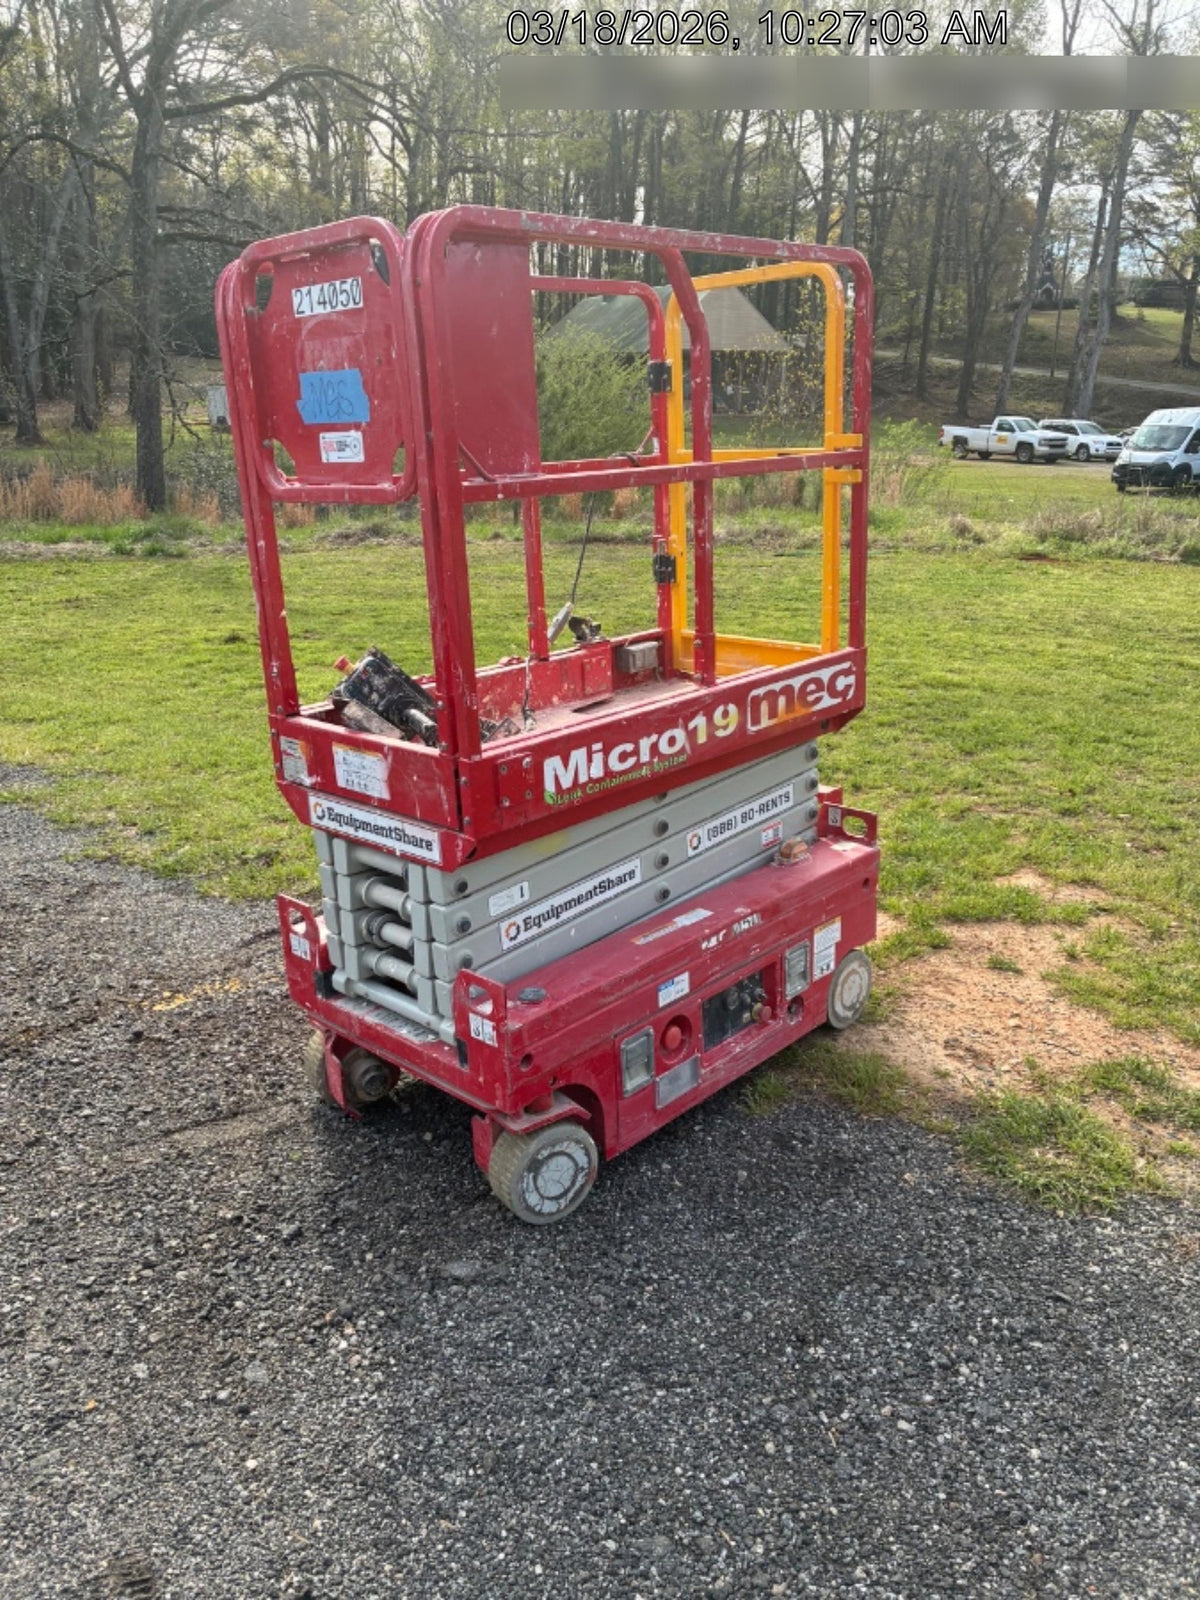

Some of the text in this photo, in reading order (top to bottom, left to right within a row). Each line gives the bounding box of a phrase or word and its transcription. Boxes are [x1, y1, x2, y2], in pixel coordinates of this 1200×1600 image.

[294, 278, 363, 316] 214050
[326, 806, 433, 852] EquipmentShare
[707, 815, 737, 842] (888)
[740, 790, 790, 824] 80-RENTS
[523, 867, 637, 932] EquipmentShare
